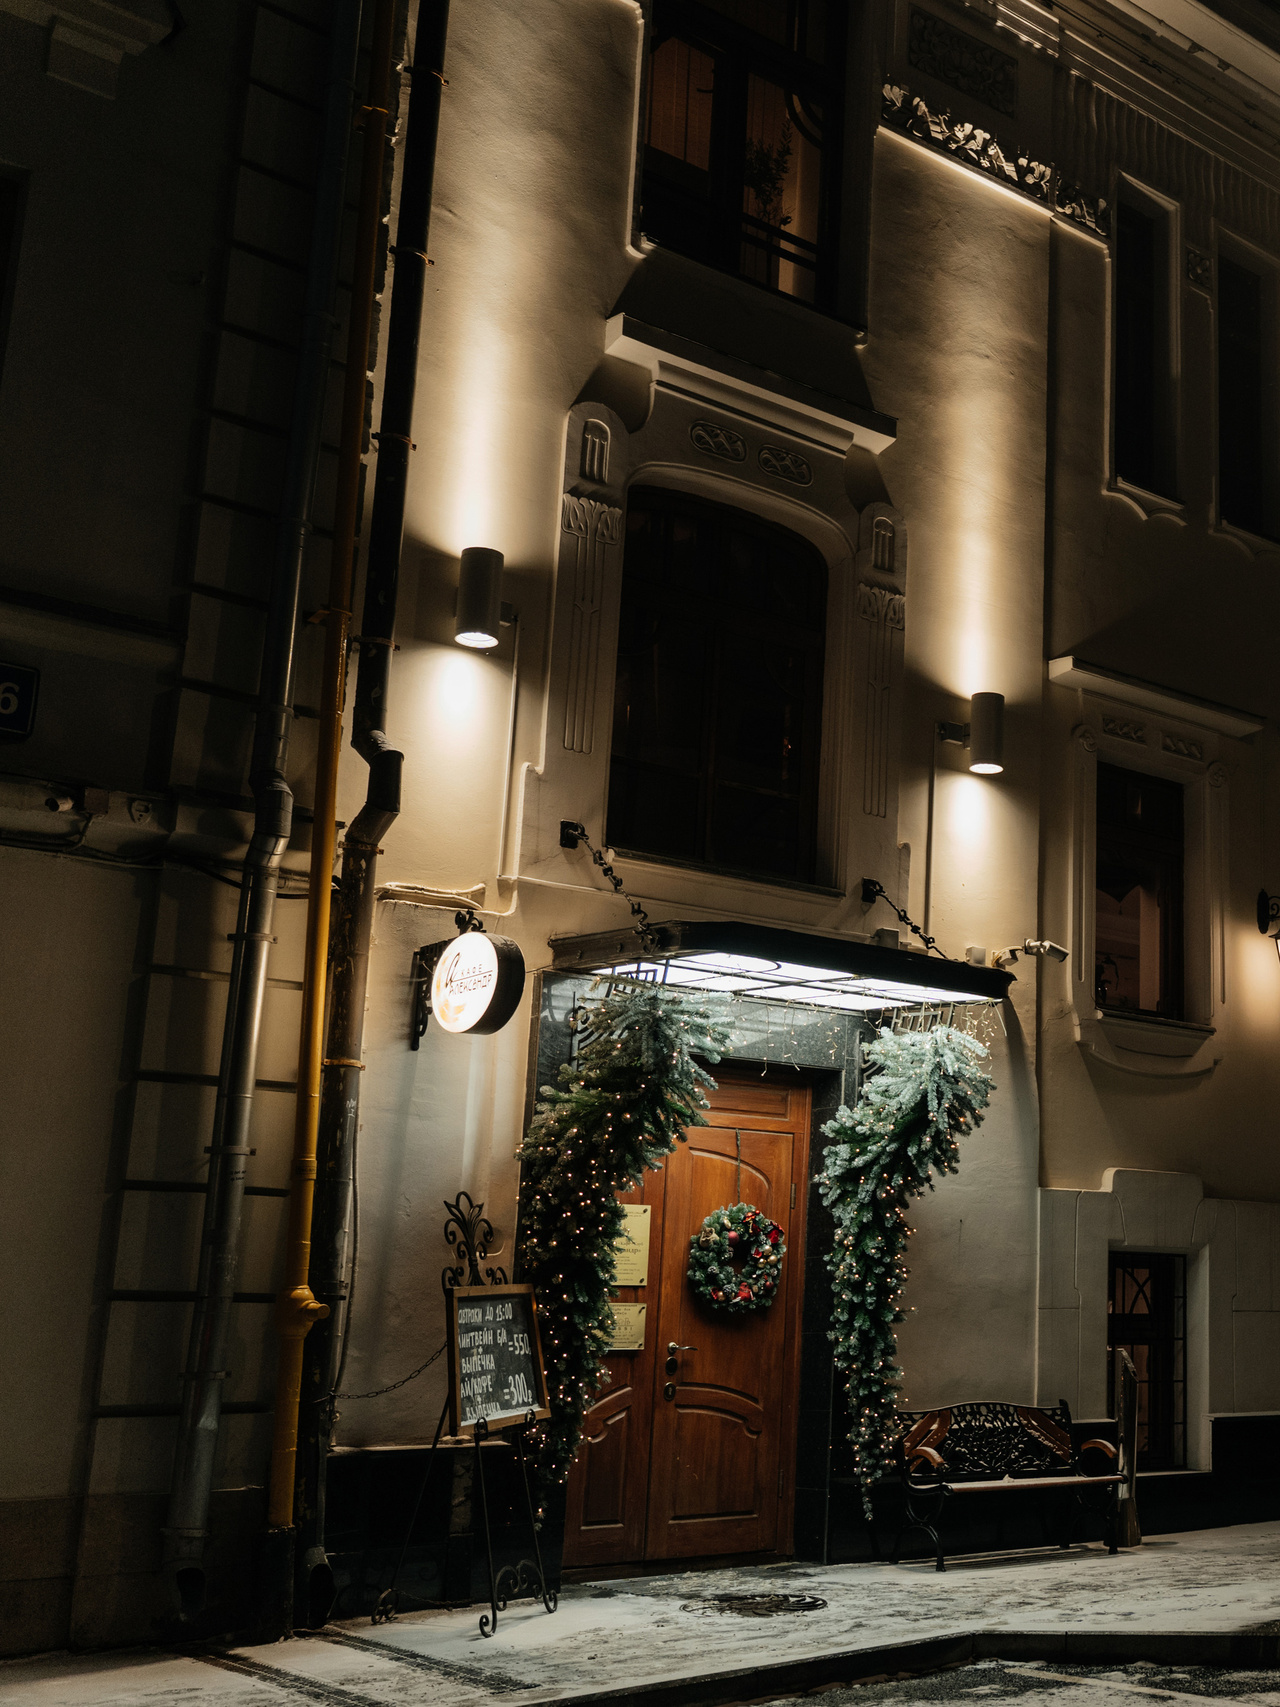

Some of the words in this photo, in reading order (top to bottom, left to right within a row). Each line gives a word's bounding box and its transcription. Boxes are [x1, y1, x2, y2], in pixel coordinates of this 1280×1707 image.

[485, 1303, 494, 1321] ДО
[496, 1303, 513, 1321] 15:00
[458, 1328, 493, 1348] ИНТВЕЙН
[461, 1354, 496, 1374] ВЫПЕЧКА
[460, 1375, 493, 1398] АЙ/КОФЕ
